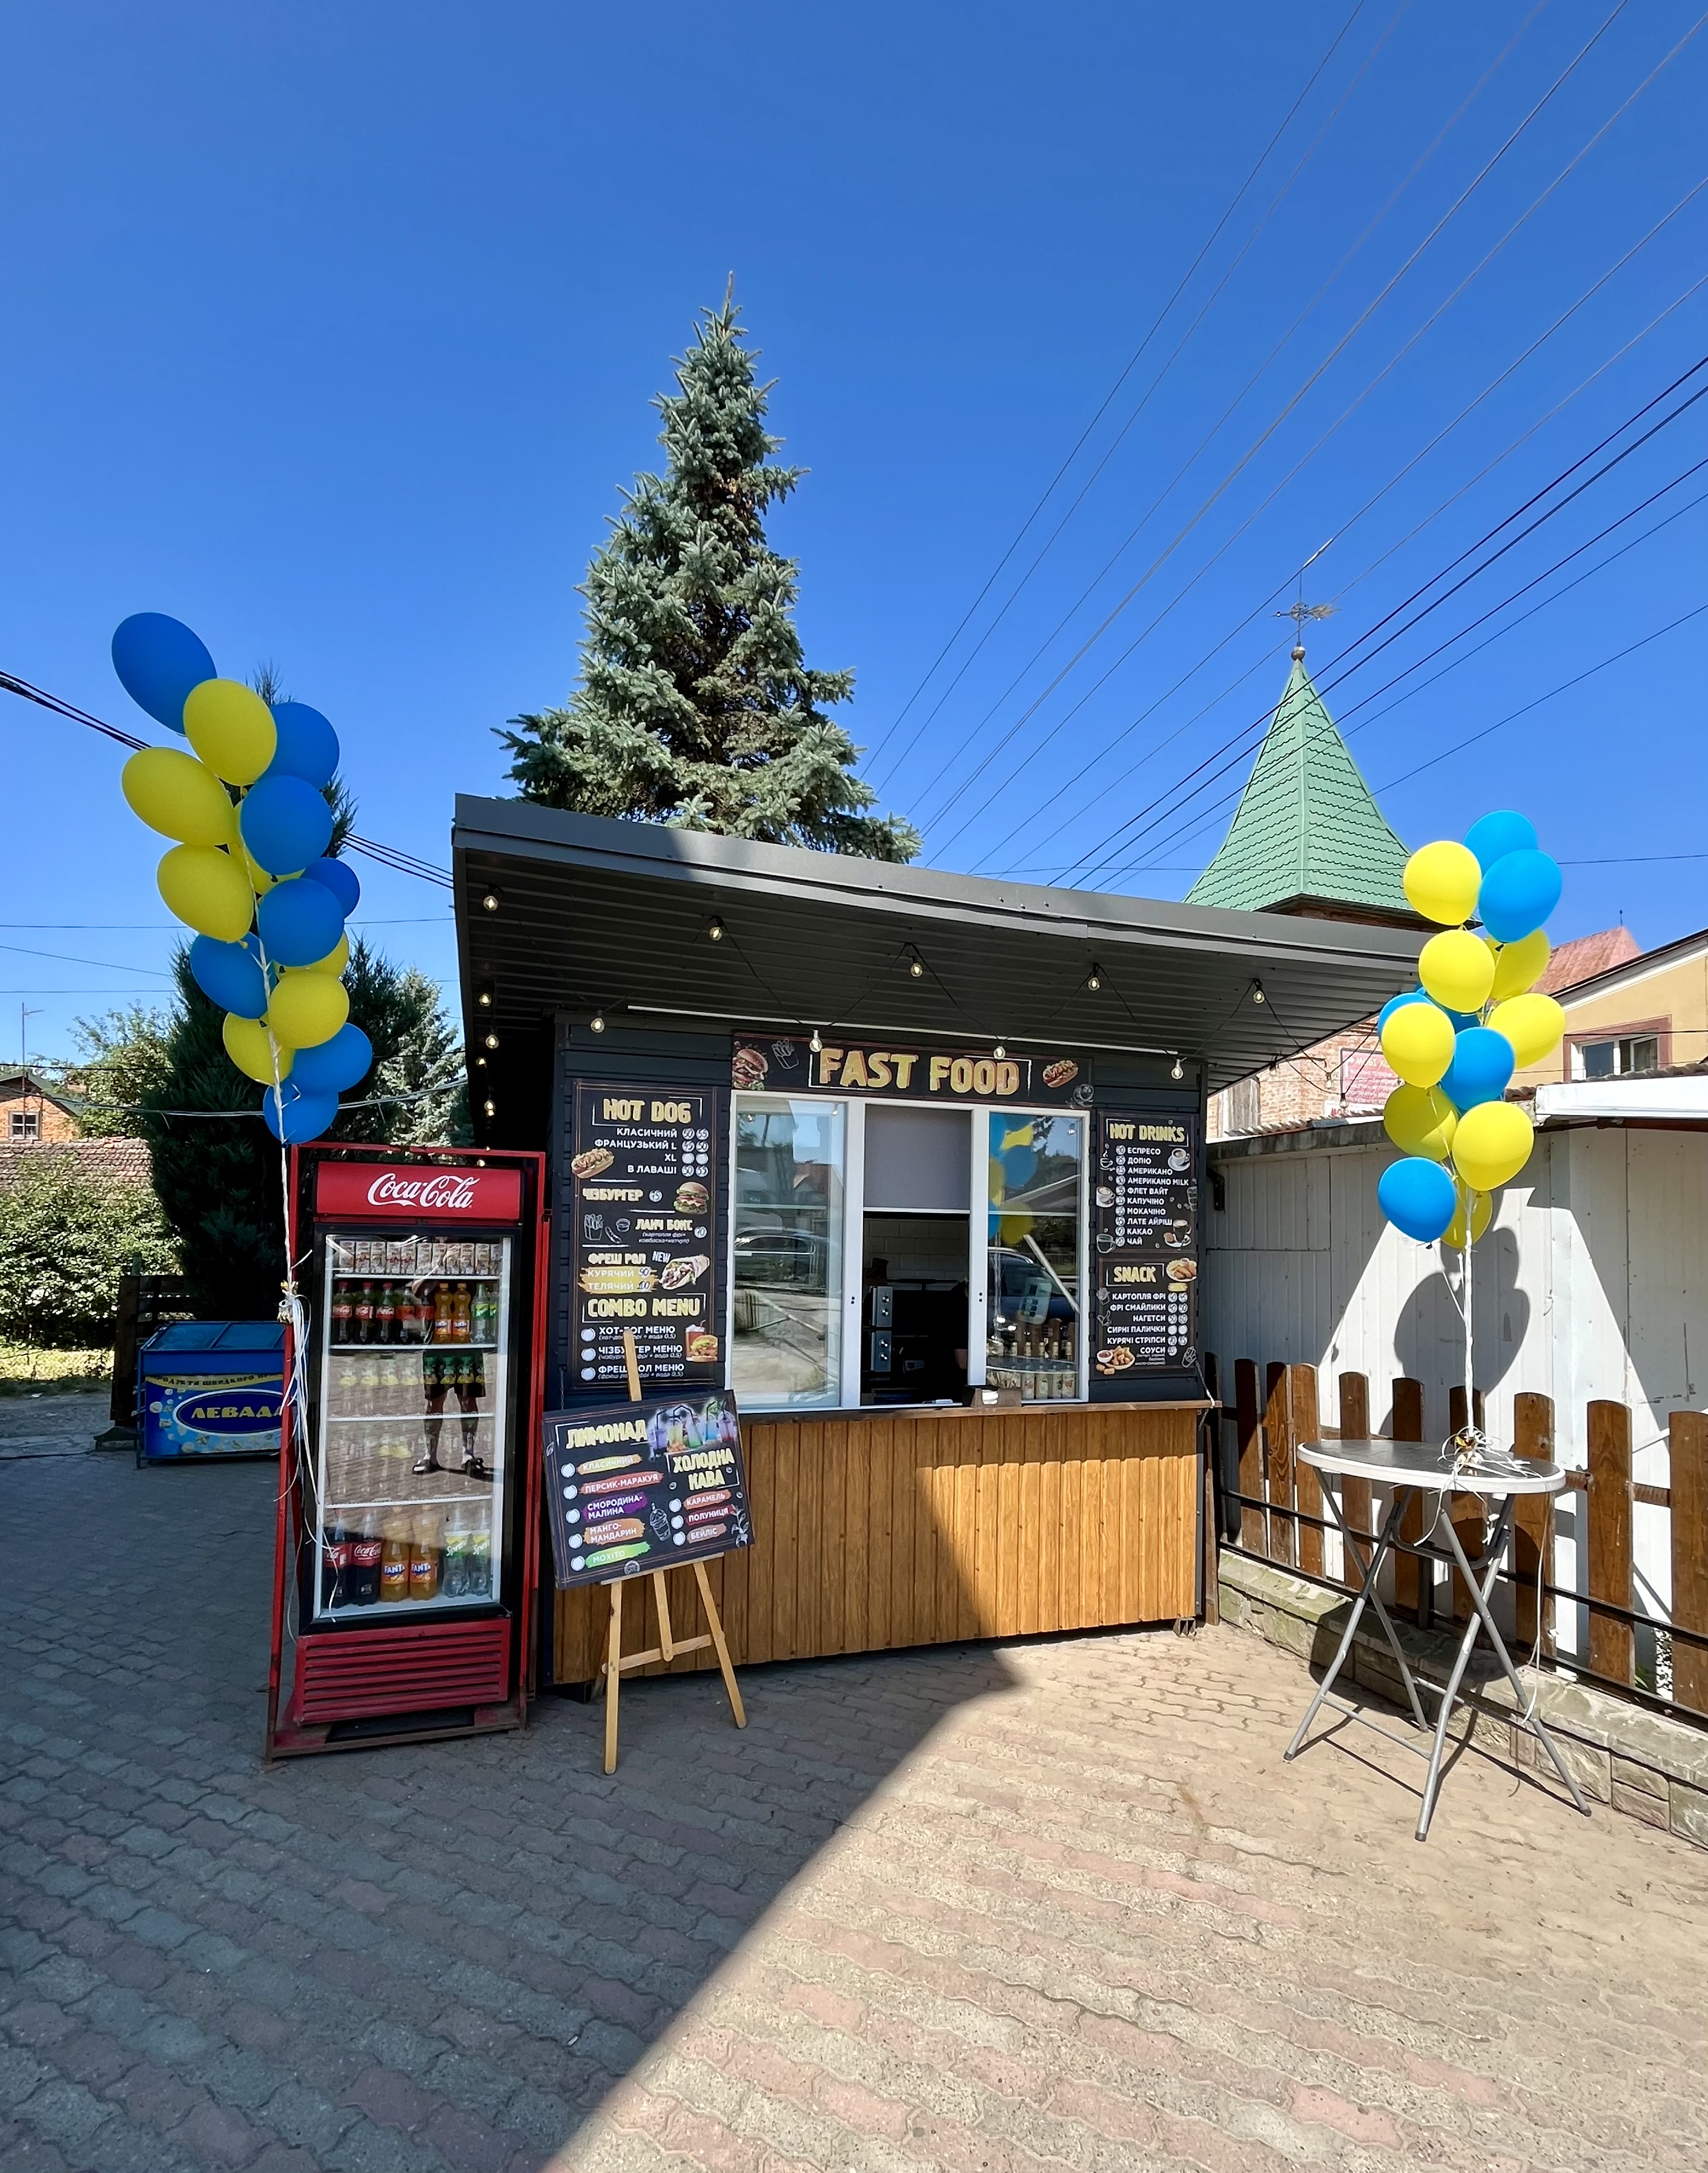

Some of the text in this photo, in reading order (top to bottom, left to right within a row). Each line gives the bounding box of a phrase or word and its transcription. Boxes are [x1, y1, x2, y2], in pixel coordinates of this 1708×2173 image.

[819, 1048, 1020, 1095] FAST FOOD
[603, 1099, 692, 1123] HOT DOG
[617, 1128, 677, 1138] КЛАСИЧНИЙ
[1110, 1123, 1185, 1142] HOT DRINKS
[594, 1139, 669, 1149] ФРАНЦУЗЬКИЙ
[1127, 1146, 1161, 1155] ЕСПРЕСО
[637, 1165, 677, 1174] ЛАВАШІ
[1127, 1177, 1171, 1185] АМЕРИКАНО
[367, 1172, 480, 1209] Coca-Cola
[1149, 1186, 1168, 1196] ВАЙТ
[635, 1219, 663, 1231] ЛАНЧ
[667, 1219, 693, 1231] БОКС
[1148, 1217, 1173, 1226] АЙРІШ
[1127, 1237, 1142, 1245] ЧАЙ
[588, 1252, 646, 1265] ФРЕШ РОЛ
[652, 1251, 671, 1263] NEW
[588, 1268, 634, 1277] КУРЯЧИЙ
[1113, 1266, 1157, 1283] SNACK
[588, 1281, 634, 1290] ТЕЛЯЧИЙ
[588, 1297, 700, 1317] COMBO MENU
[1125, 1302, 1166, 1311] СМАЙЛИКИ
[598, 1325, 675, 1335] ХОТ-ОГ МЕНЮ
[598, 1344, 683, 1354] ЧІЗБУЕР МЕНЮ
[655, 1363, 684, 1372] МЕНЮ
[566, 1419, 648, 1449] ЛИМОНАД
[583, 1455, 634, 1472] КЛАСИЧНИЙ
[673, 1448, 735, 1473] ХОЛОДНА
[585, 1473, 658, 1493] ПЕРСИК-МАРАКУЯ
[688, 1469, 726, 1490] КАВА
[587, 1495, 643, 1511] СМОРОДИНА-
[686, 1493, 726, 1506] КАРАМЕЛЬ
[588, 1506, 624, 1520] МАЛИНА
[688, 1507, 729, 1523] ПОЛУНИЦЯ
[590, 1523, 622, 1534] МАНГО-
[690, 1527, 718, 1540] БЕЙЛІС
[590, 1527, 637, 1544] МАНДАРИН
[592, 1550, 625, 1563] МОХІТО
